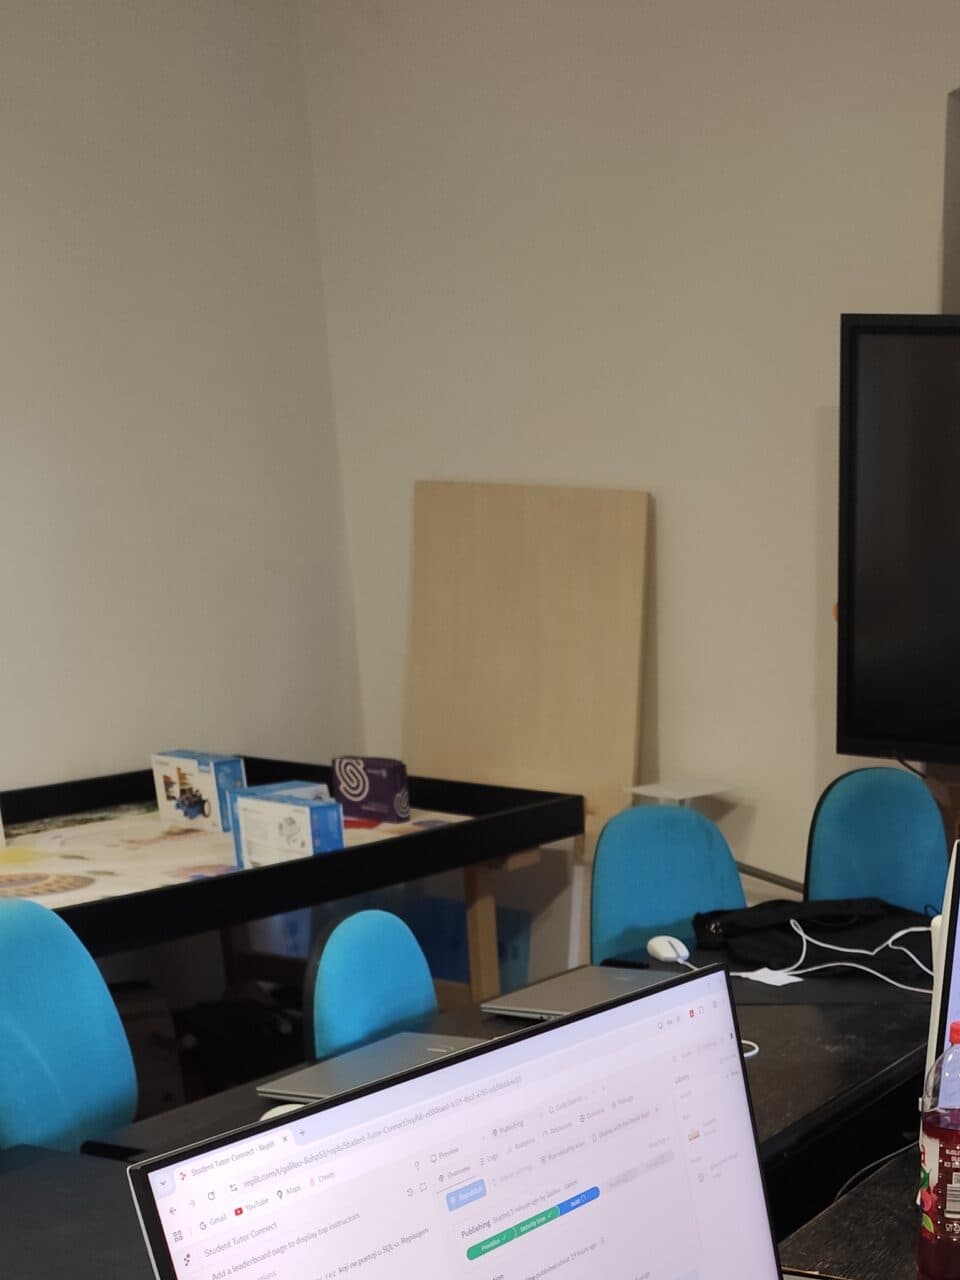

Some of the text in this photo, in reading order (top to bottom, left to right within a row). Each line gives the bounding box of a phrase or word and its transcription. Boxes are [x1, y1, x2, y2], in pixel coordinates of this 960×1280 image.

[209, 1214, 226, 1225] Gmail
[245, 1197, 269, 1211] YouTube
[286, 1184, 301, 1196] Maps
[204, 1222, 277, 1258] Student Tutor Connect
[232, 1250, 271, 1273] leaderboard
[272, 1245, 288, 1257] page
[288, 1240, 295, 1249] to
[295, 1230, 318, 1247] display
[317, 1226, 328, 1237] top
[328, 1212, 360, 1231] instructors
[461, 1220, 490, 1240] Publishing
